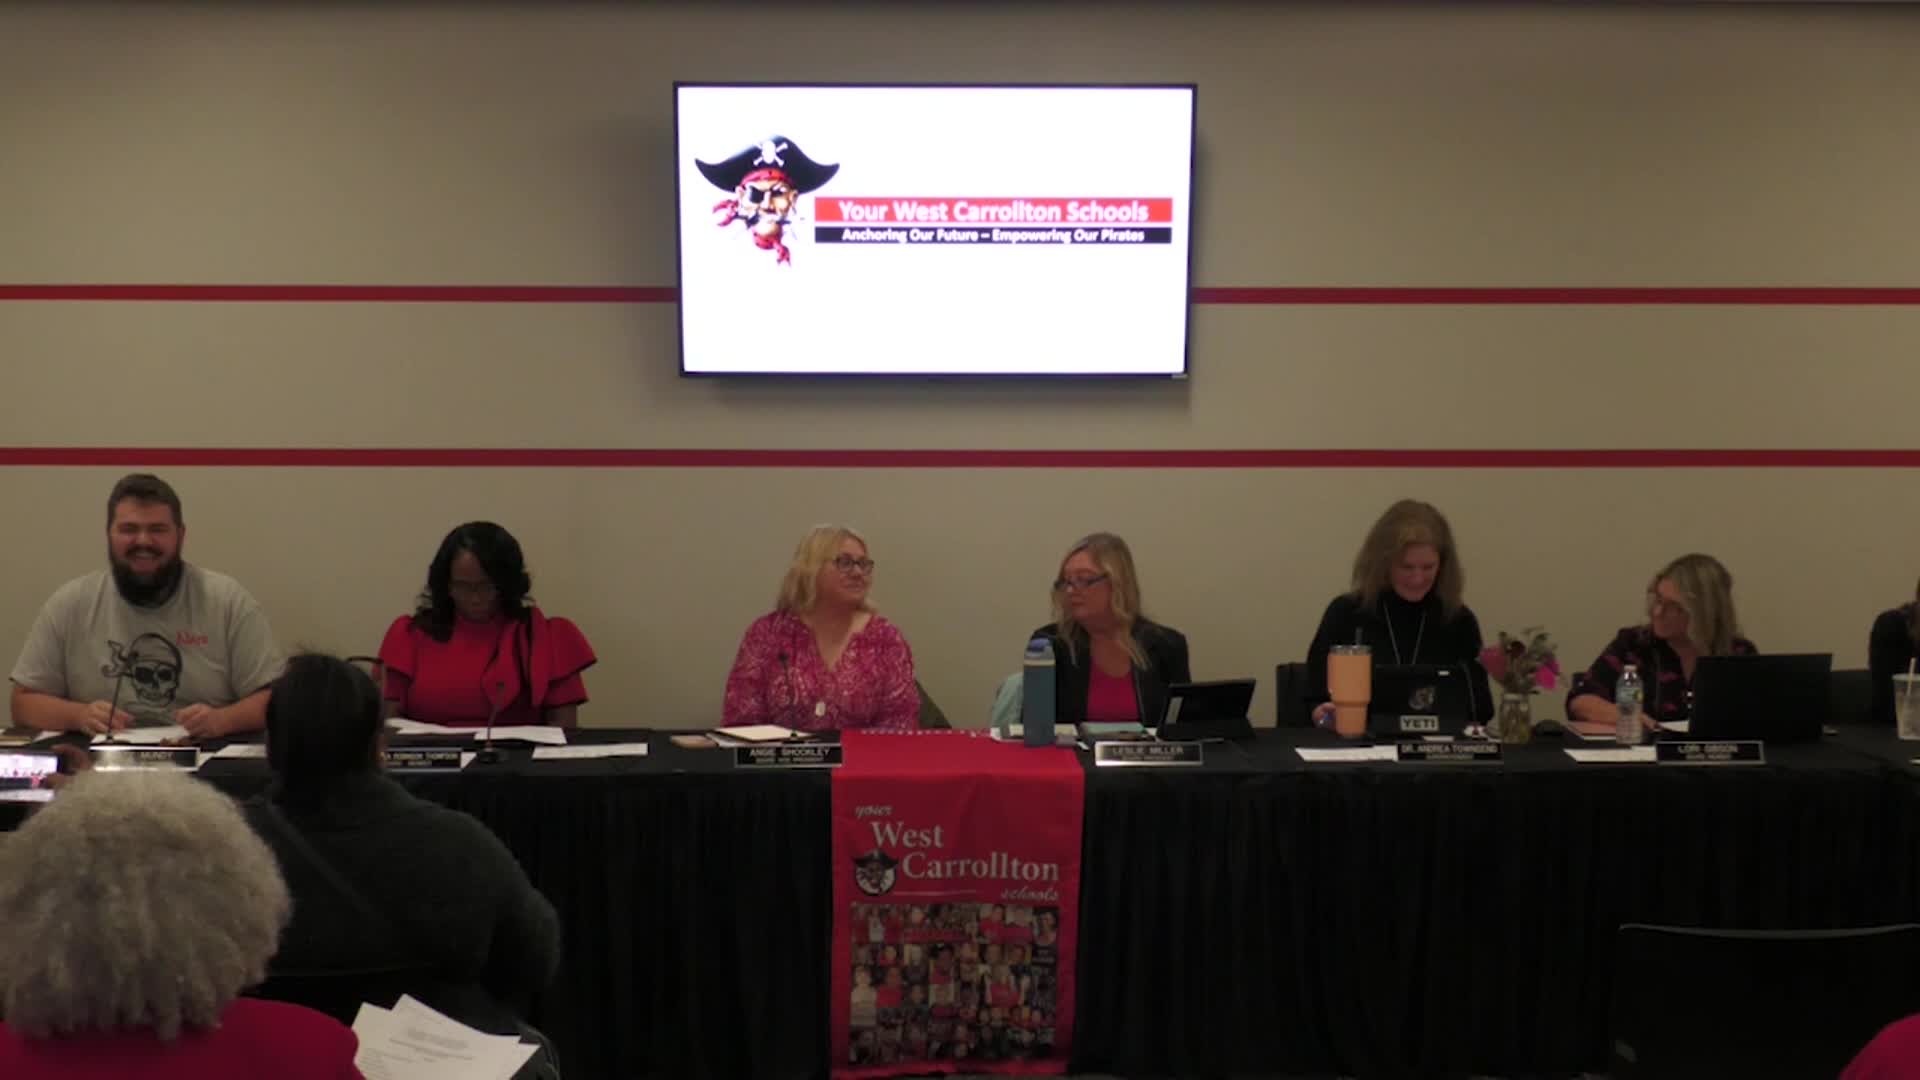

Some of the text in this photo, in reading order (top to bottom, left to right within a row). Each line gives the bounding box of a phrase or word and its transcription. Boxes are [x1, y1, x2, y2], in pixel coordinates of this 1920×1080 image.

[838, 200, 1149, 222] Your West Carrollton Schools
[842, 229, 908, 243] Anchoring
[909, 229, 934, 241] Our
[937, 229, 979, 241] Future
[992, 229, 1072, 244] Empowering
[1073, 229, 1098, 241] Our
[1101, 229, 1145, 242] Pirates
[1403, 719, 1436, 728] YETI
[1149, 746, 1184, 755] MILLER
[855, 804, 893, 819] your
[870, 820, 944, 848] West
[901, 851, 1060, 882] Carrollton
[1001, 885, 1059, 902] schools
